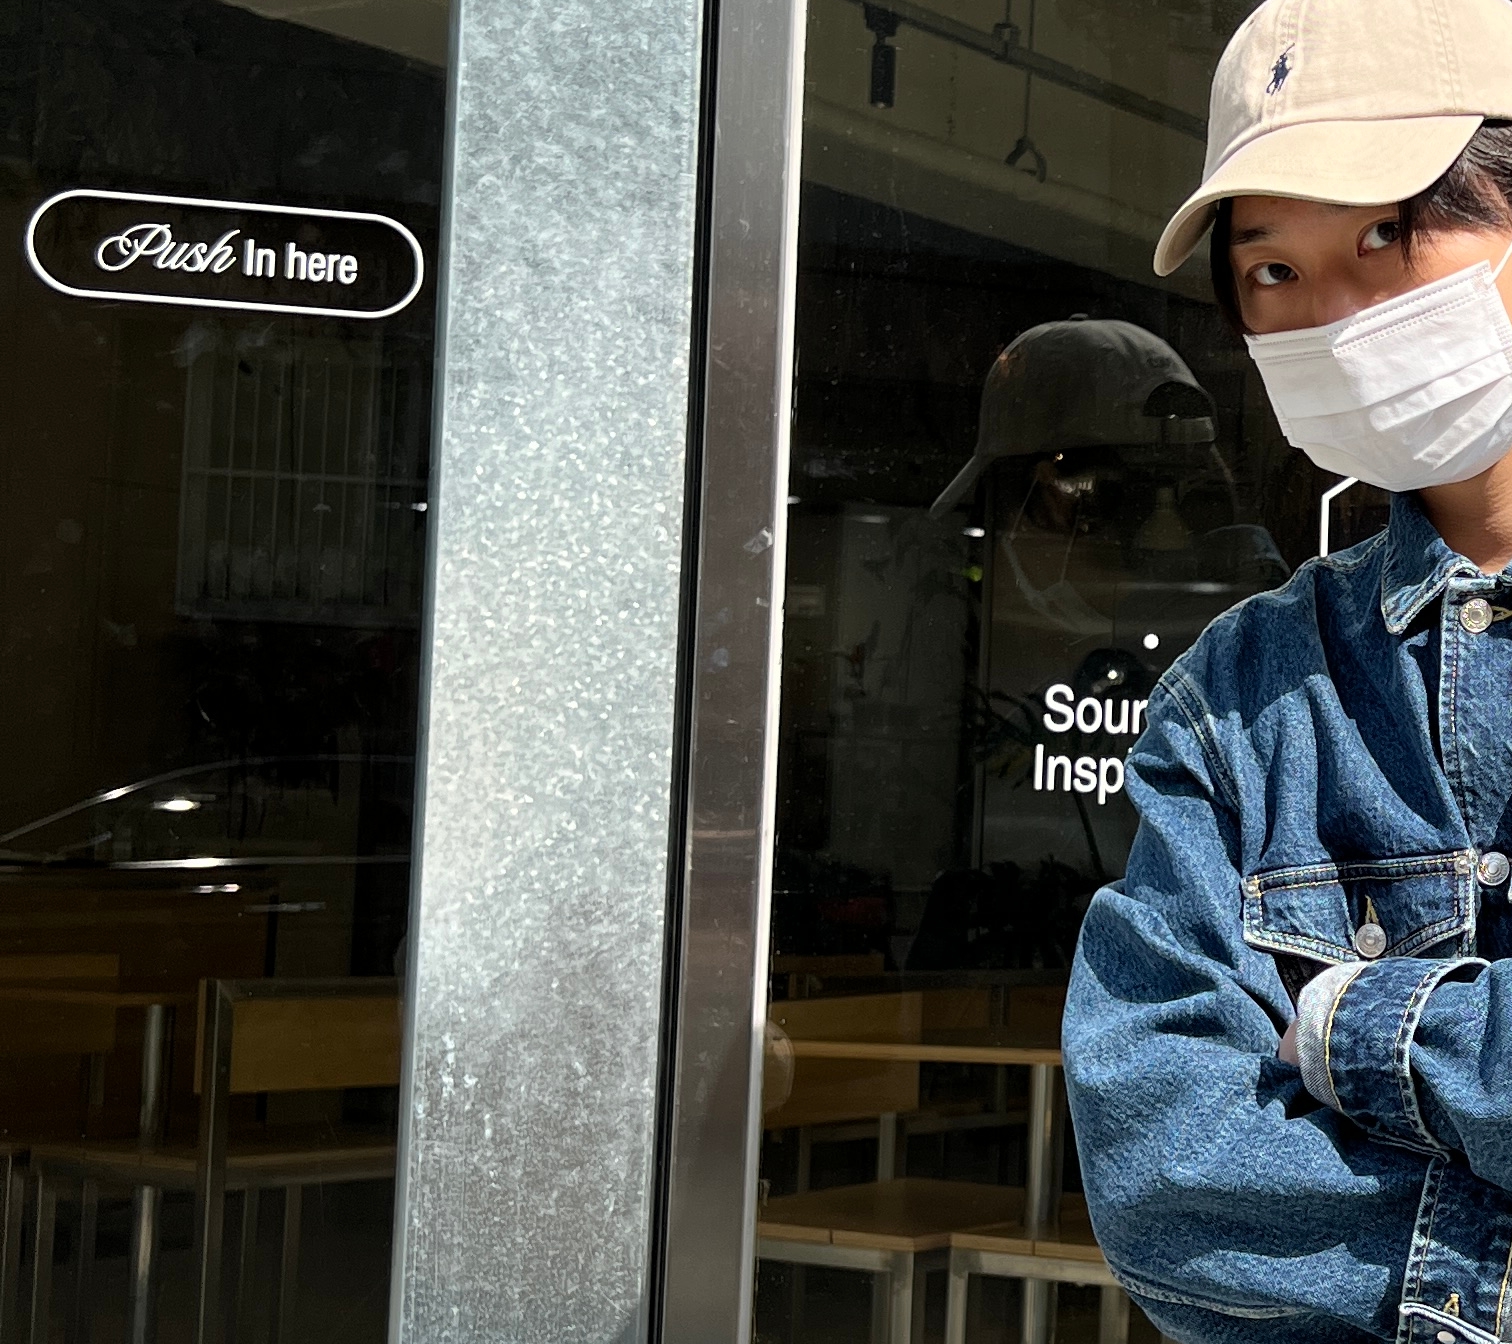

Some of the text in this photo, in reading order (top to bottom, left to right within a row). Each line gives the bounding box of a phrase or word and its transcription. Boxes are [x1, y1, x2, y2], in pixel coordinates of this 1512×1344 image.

[97, 223, 358, 285] Push In here
